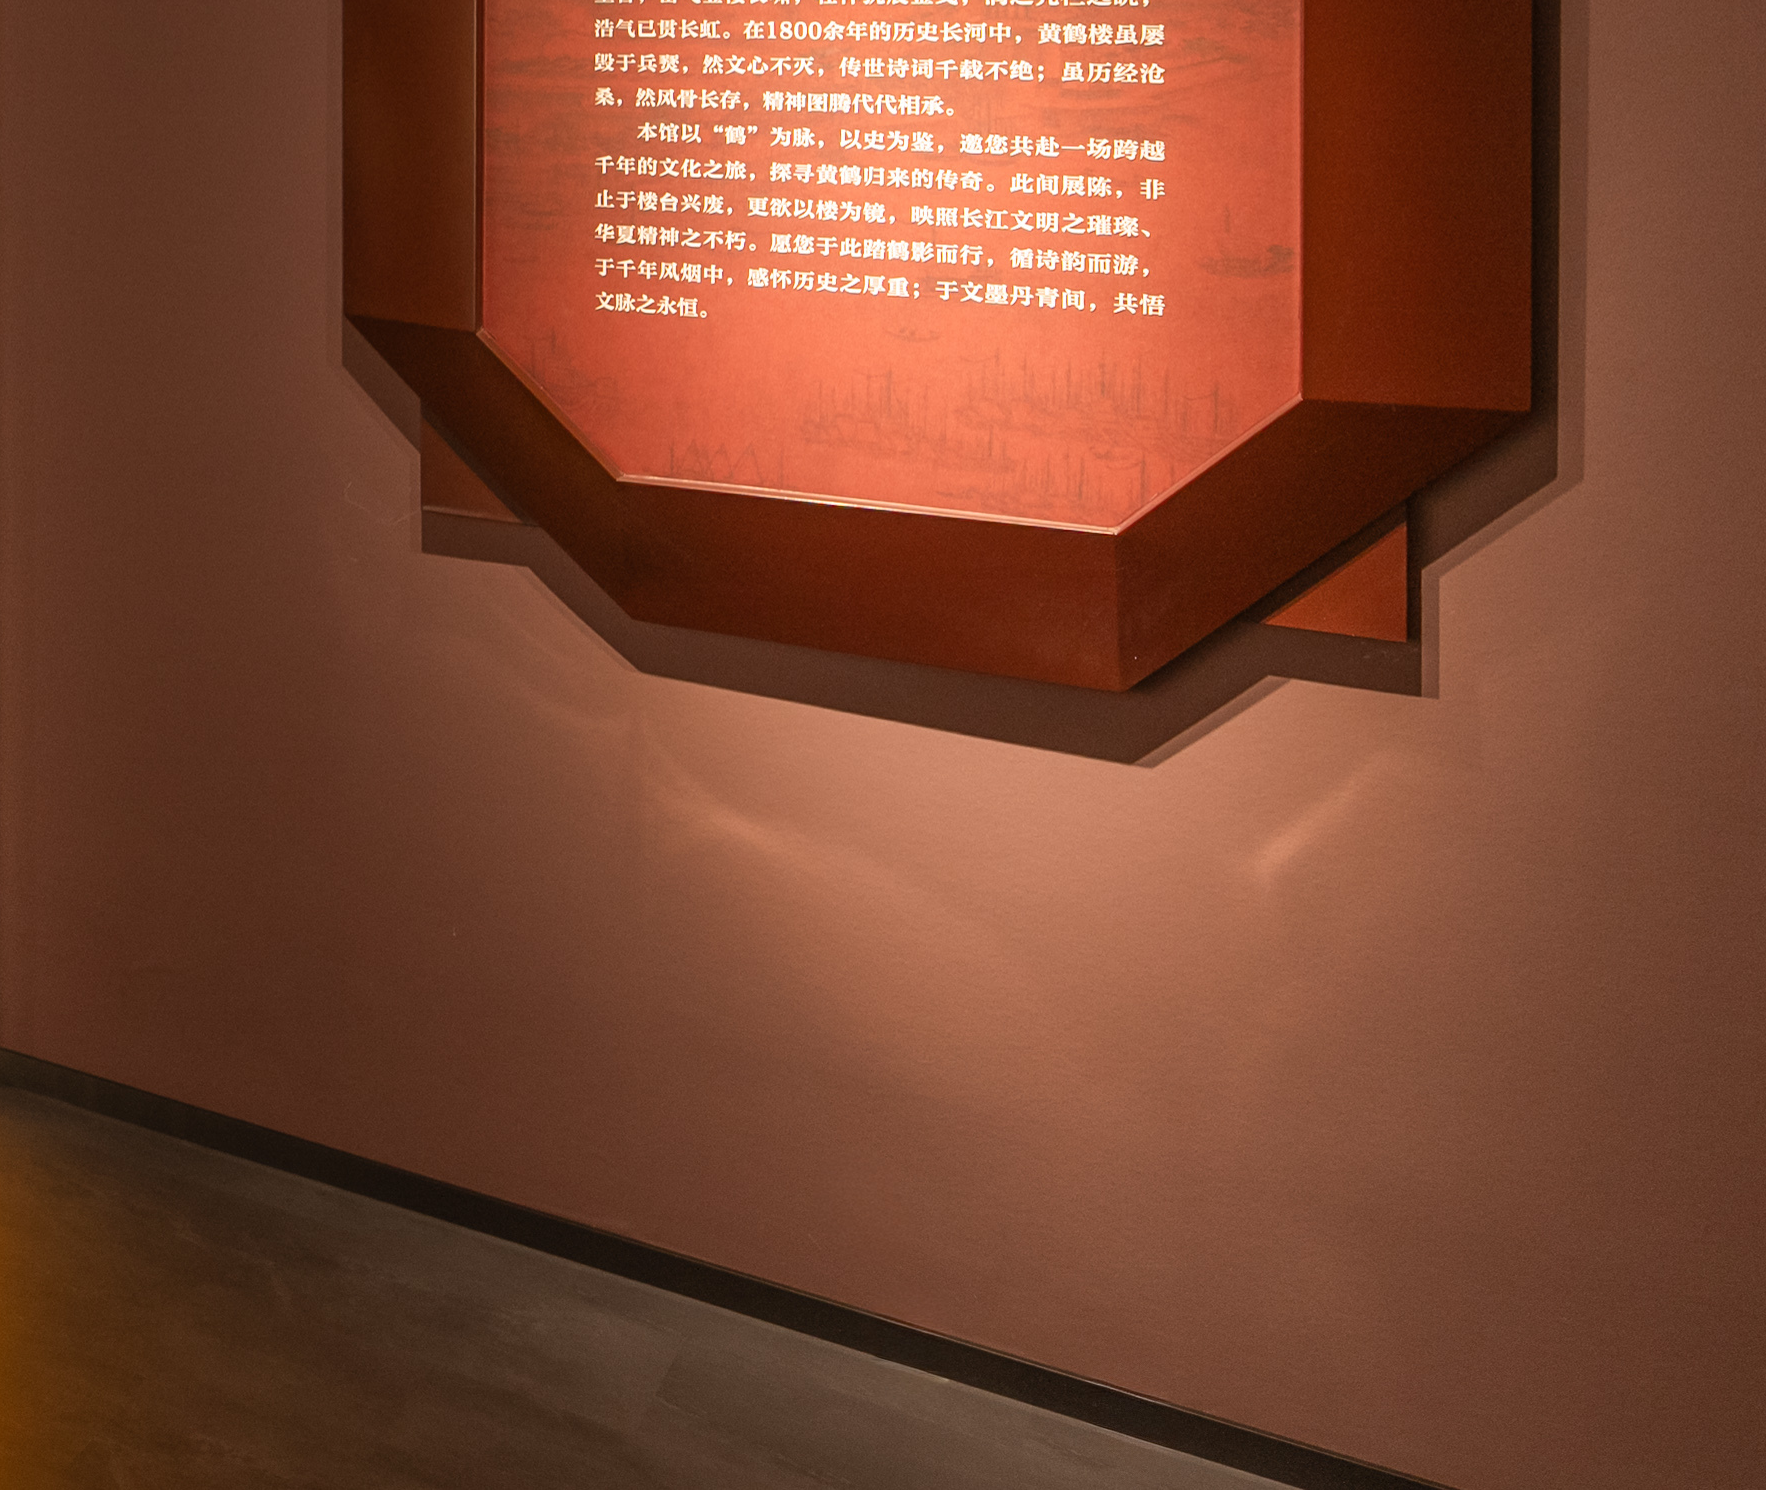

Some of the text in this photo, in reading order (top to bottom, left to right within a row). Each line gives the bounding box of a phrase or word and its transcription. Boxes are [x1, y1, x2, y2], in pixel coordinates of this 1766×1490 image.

[594, 87, 955, 117] 桑，然风骨长存，精神图腾代代相承。
[595, 291, 708, 318] 文脉之永恒。
